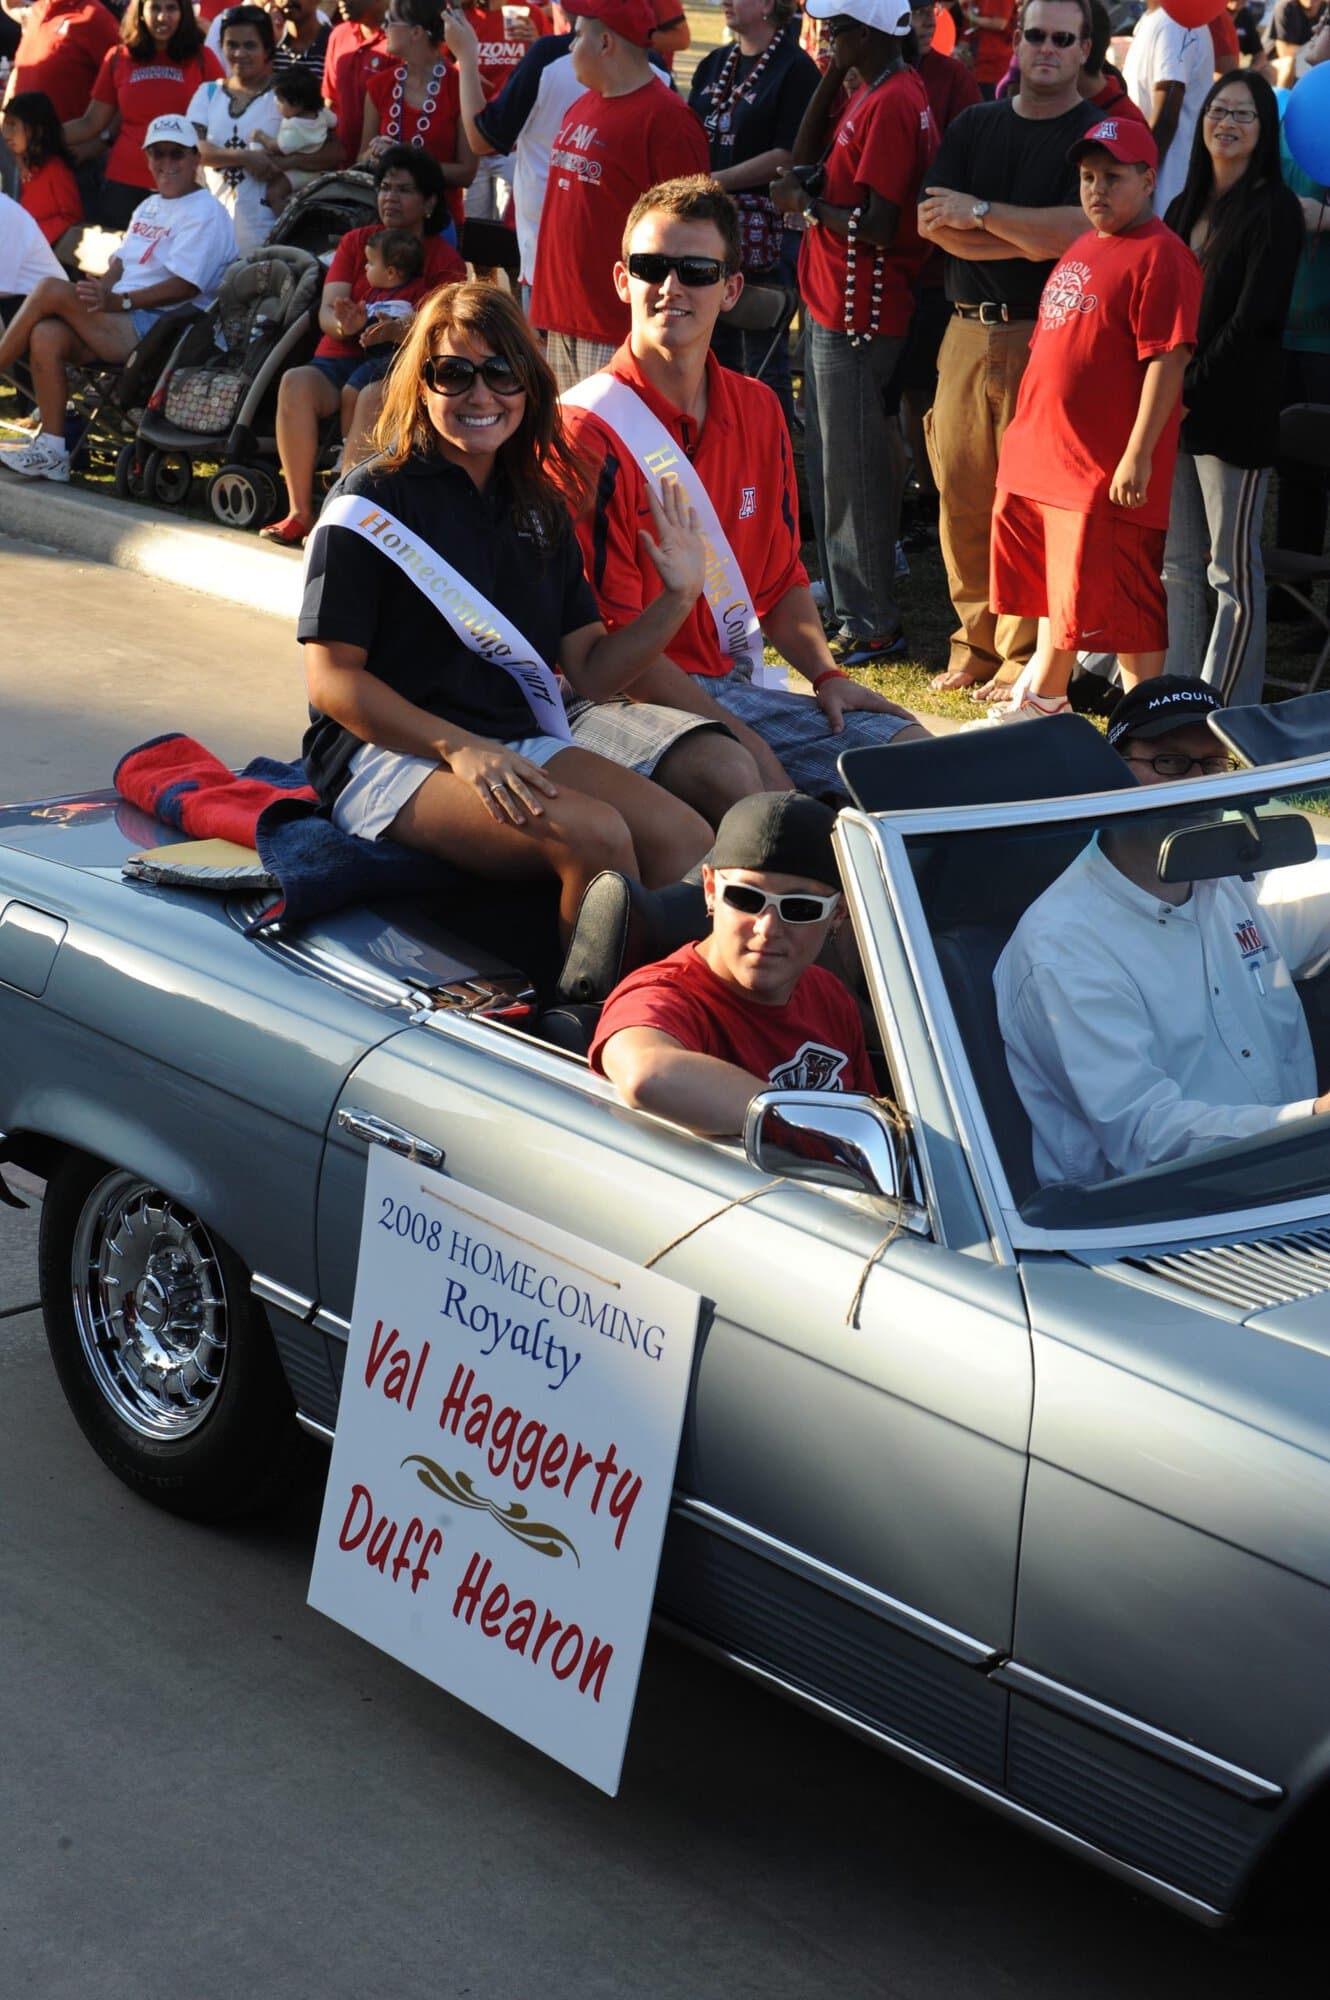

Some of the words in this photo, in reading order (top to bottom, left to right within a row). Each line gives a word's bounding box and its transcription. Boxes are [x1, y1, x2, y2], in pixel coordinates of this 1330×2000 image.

[478, 41, 525, 57] IZONA
[565, 124, 598, 151] AM
[1058, 261, 1092, 286] RIZONA
[643, 445, 732, 607] Homming
[739, 487, 755, 519] A
[357, 509, 512, 659] Homecoming
[378, 1197, 441, 1252] 2008
[447, 1229, 665, 1361] HOMECOMING
[440, 1277, 582, 1390] Royalty
[364, 1319, 431, 1411] Val
[439, 1363, 643, 1551] Haggerty
[338, 1484, 442, 1594] Duff
[452, 1551, 614, 1703] Hearon
